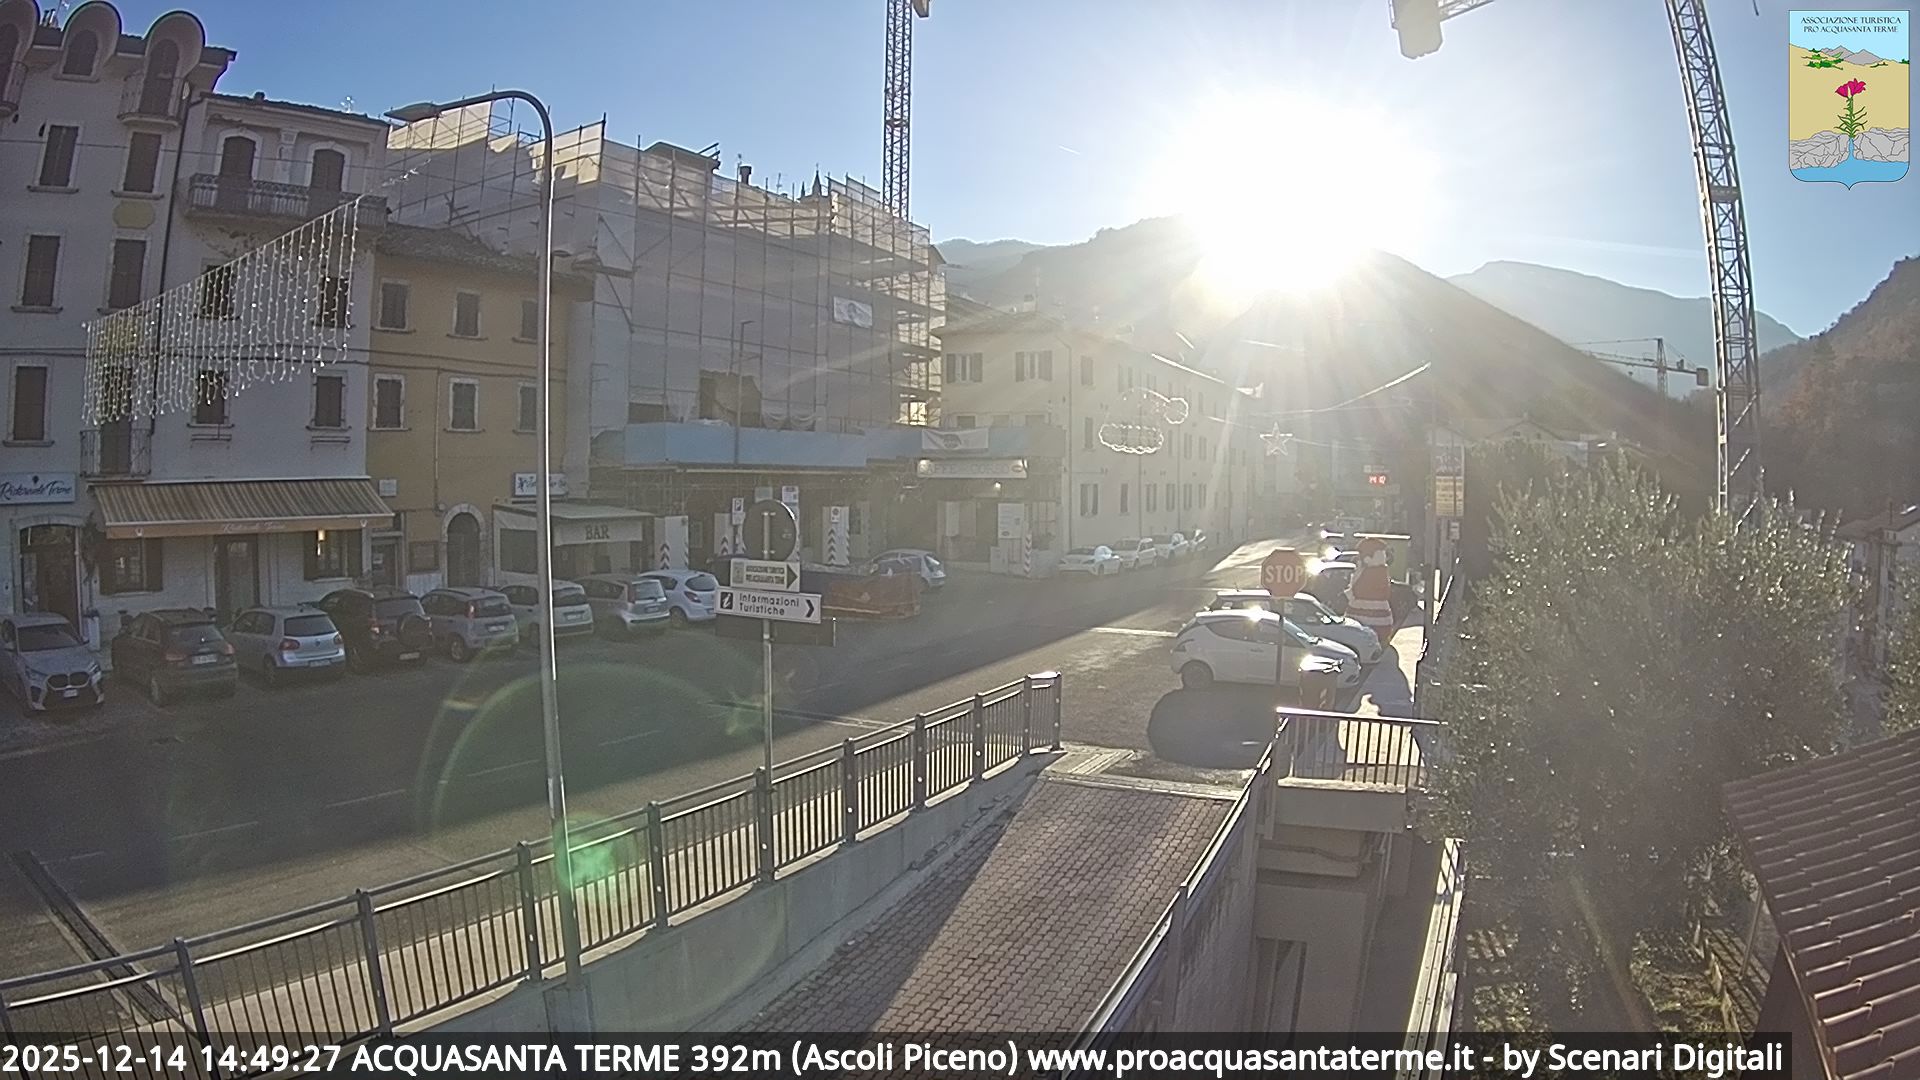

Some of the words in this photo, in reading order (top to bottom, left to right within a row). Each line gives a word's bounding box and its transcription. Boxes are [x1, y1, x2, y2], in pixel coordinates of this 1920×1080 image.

[585, 524, 610, 540] BAR
[1265, 564, 1304, 583] STOP
[740, 593, 800, 607] Informazioni
[740, 603, 785, 615] Turistiche
